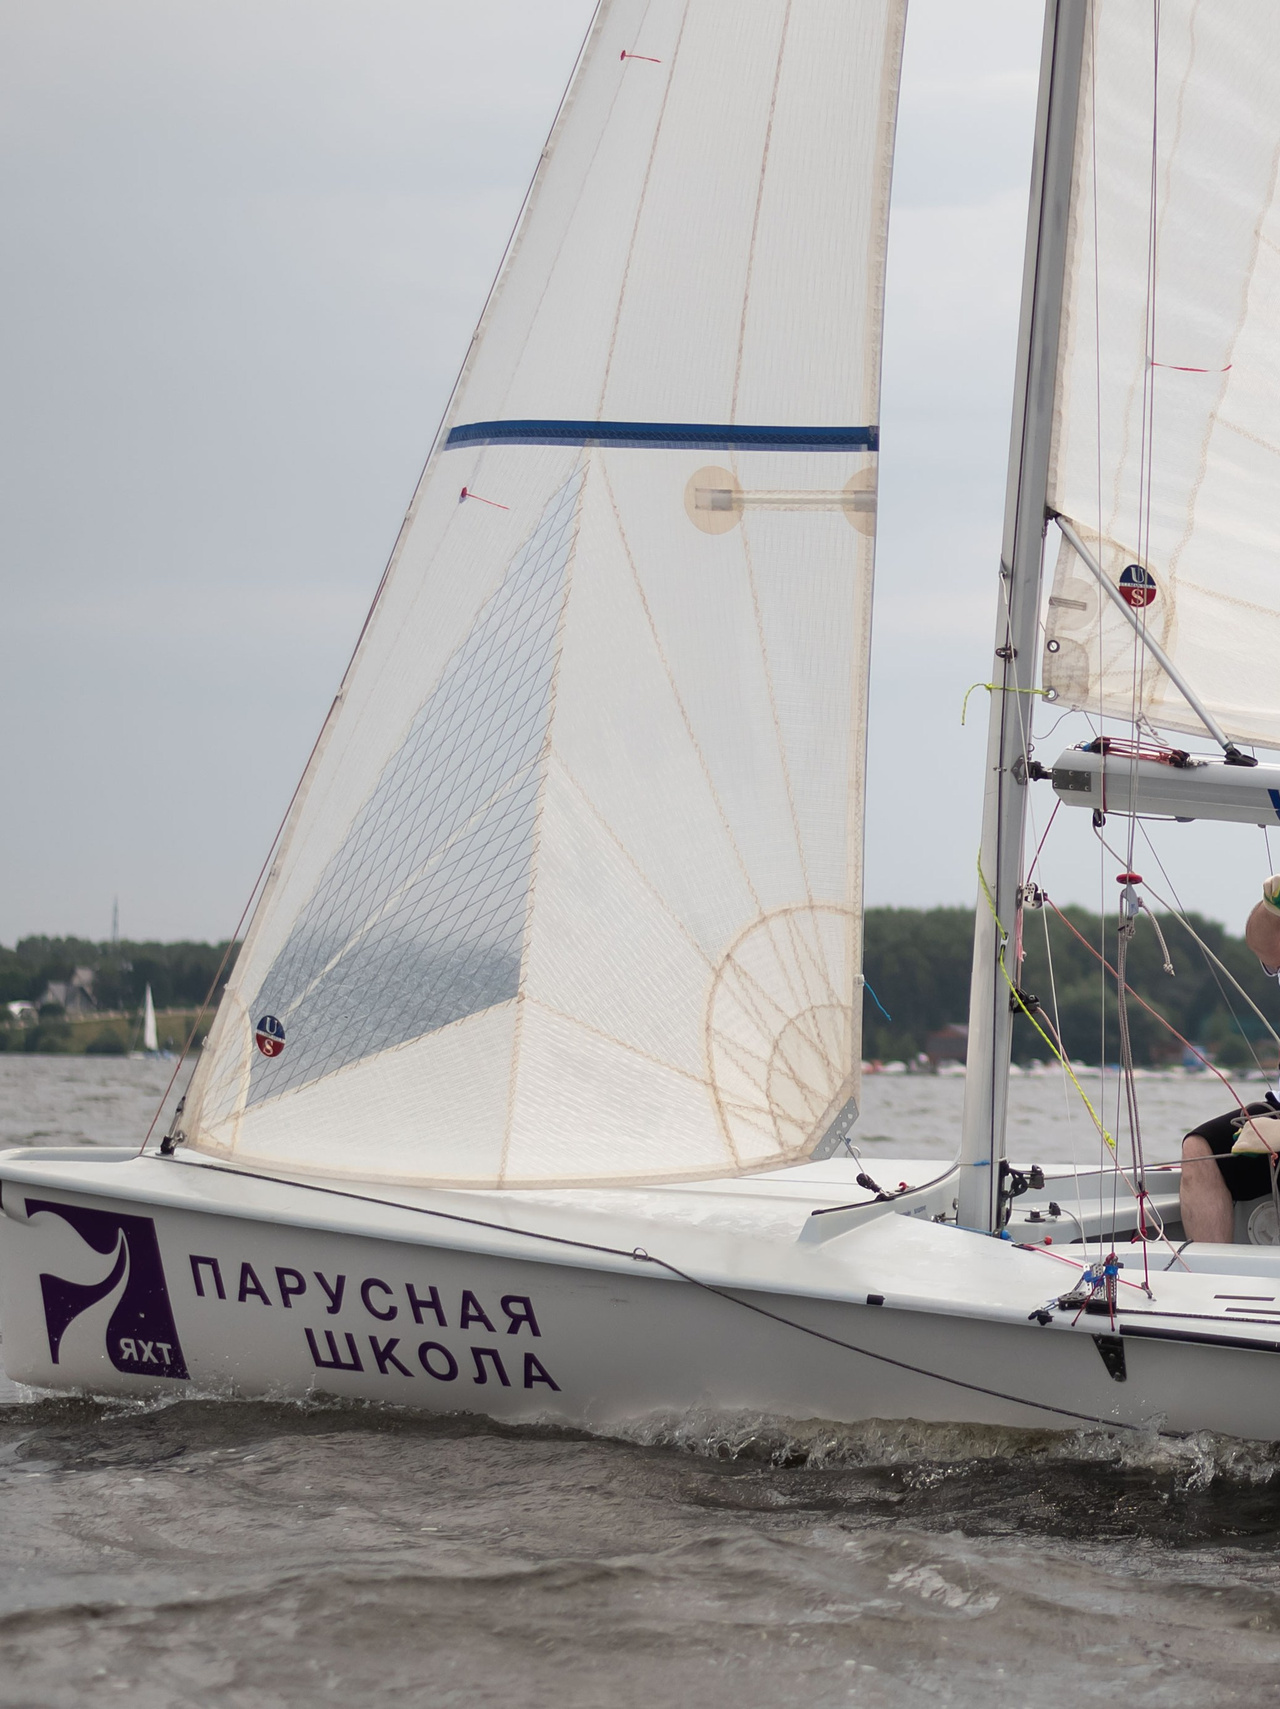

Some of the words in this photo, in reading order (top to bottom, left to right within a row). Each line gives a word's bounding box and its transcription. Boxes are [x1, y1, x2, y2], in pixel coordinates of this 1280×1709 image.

[189, 1254, 542, 1338] ПАРУСНАЯ
[119, 1337, 172, 1365] ЯХТ
[304, 1327, 562, 1392] ШКОЛА
